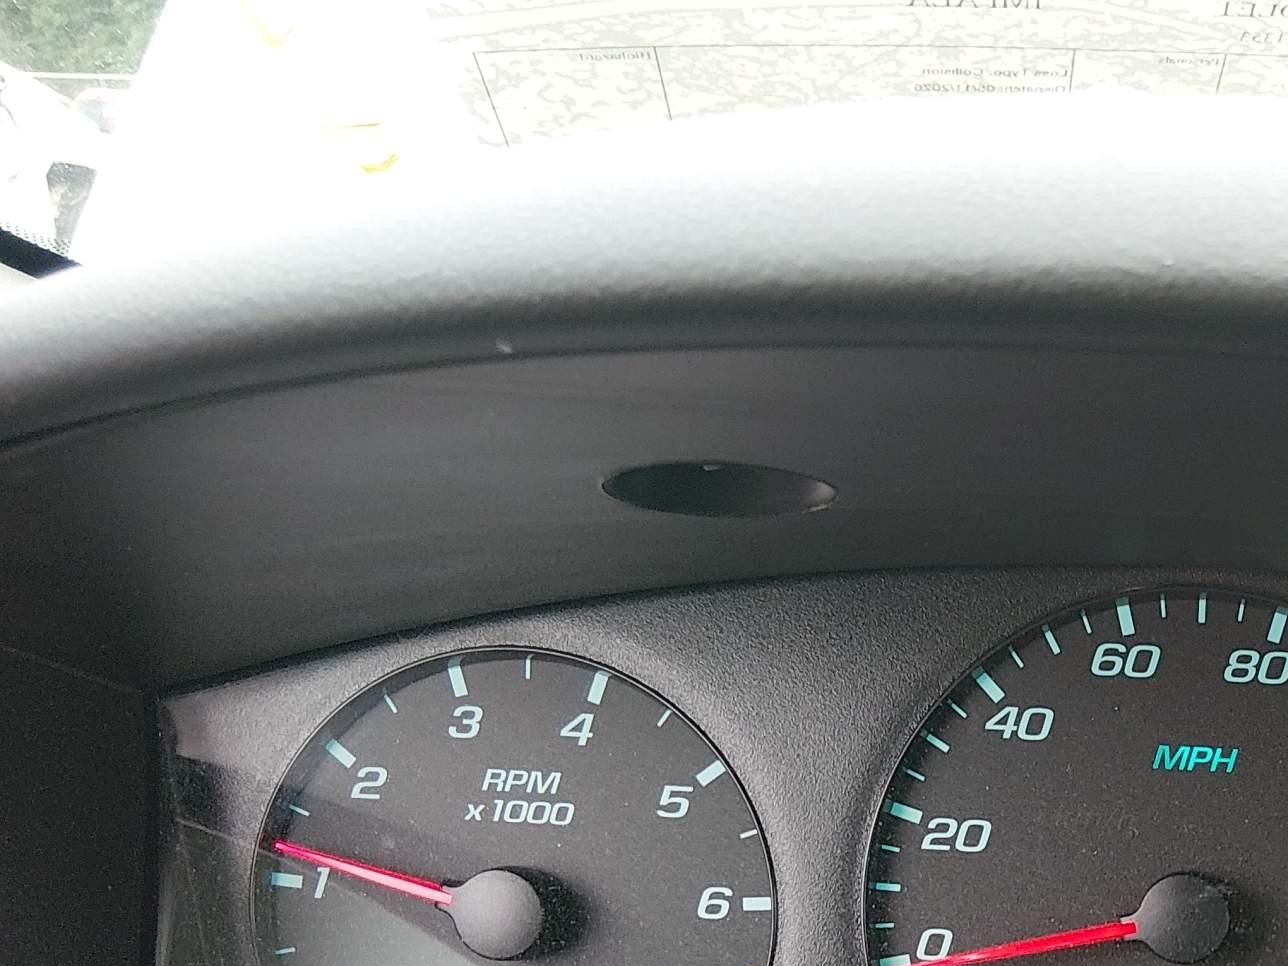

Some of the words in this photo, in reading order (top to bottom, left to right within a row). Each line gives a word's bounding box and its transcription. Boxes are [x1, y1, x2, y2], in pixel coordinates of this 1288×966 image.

[1091, 643, 1161, 678] 60
[448, 705, 483, 739] 3
[559, 713, 595, 746] 4
[984, 706, 1054, 741] 40
[1152, 744, 1239, 773] MPH
[350, 765, 388, 800] 2
[481, 768, 562, 795] RPM
[492, 799, 575, 826] 1000
[656, 785, 694, 818] 5
[921, 818, 992, 853] 20
[313, 866, 330, 899] 1
[697, 886, 733, 920] 6
[916, 927, 952, 959] 0
